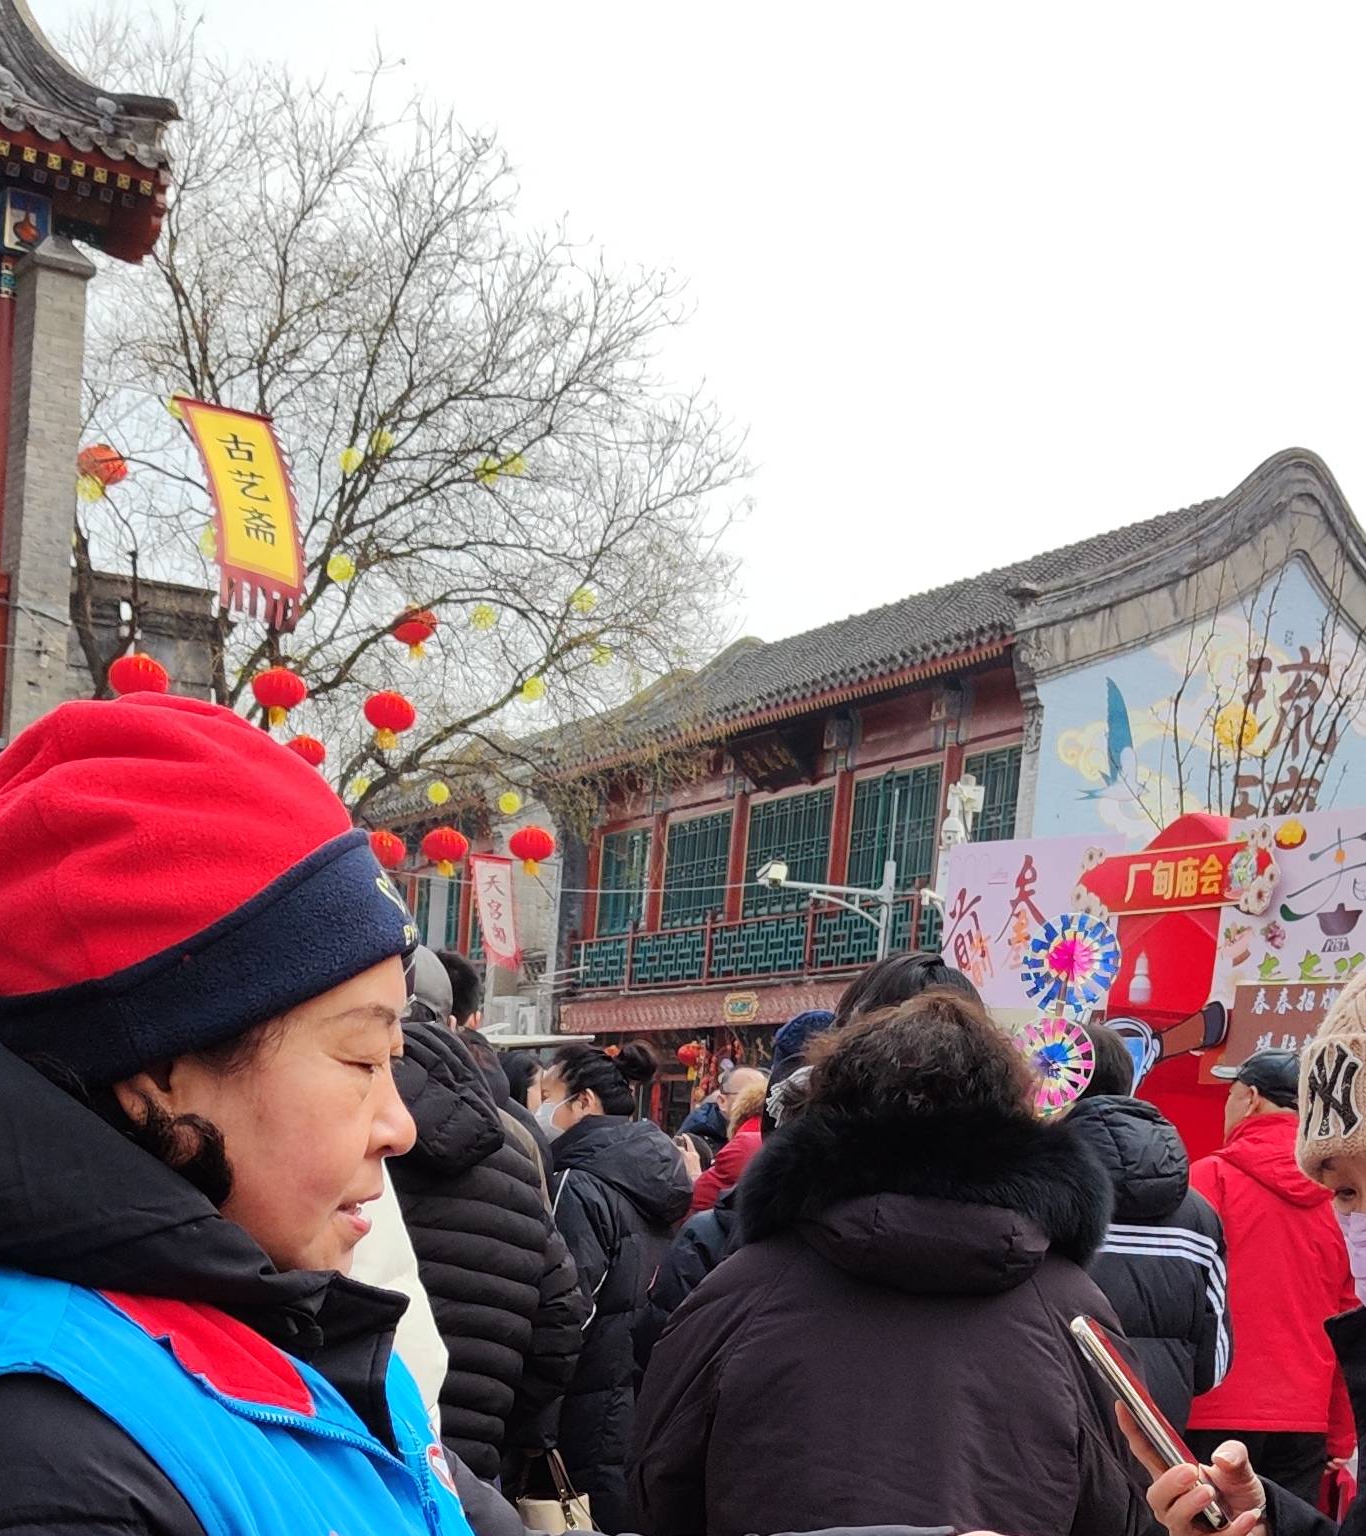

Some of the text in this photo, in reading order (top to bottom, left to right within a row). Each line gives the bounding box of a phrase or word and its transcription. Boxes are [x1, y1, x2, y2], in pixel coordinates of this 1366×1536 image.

[216, 432, 277, 547] 古艺斋
[1124, 853, 1224, 904] 厂甸庙会
